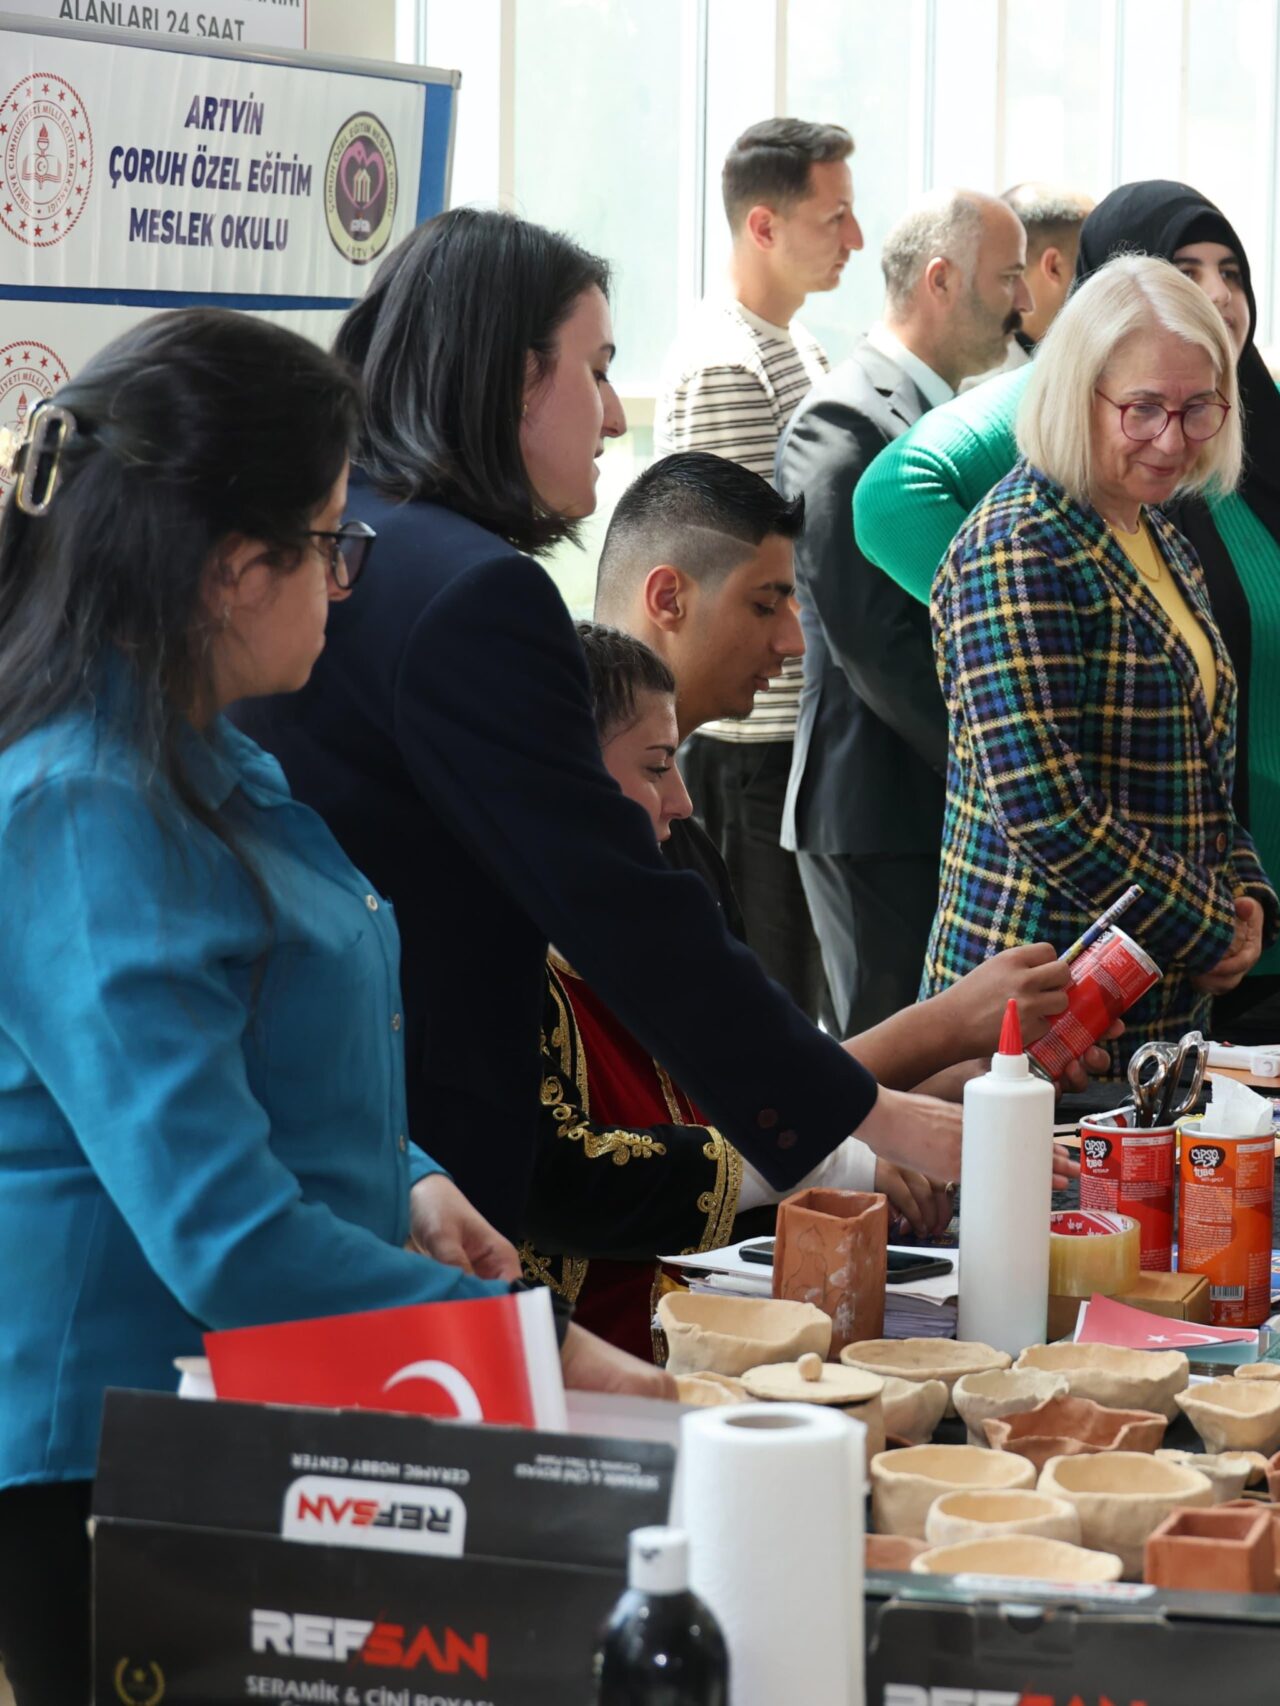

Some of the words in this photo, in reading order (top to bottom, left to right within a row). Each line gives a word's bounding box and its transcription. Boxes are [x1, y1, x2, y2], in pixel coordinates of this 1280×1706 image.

[59, 0, 159, 31] ALANLARI
[167, 10, 190, 35] 24
[197, 14, 245, 41] SAAT
[184, 92, 264, 136] ARTVİN
[109, 145, 188, 189] ÇORUH
[191, 144, 242, 191] ÖZEL
[247, 151, 312, 197] EĞİTİM
[129, 207, 216, 247] MESLEK
[221, 214, 289, 252] OKULU
[298, 1492, 452, 1533] REFSAN
[251, 1609, 488, 1680] REFSAN
[246, 1674, 340, 1705] SERAMİK
[345, 1686, 361, 1706] &
